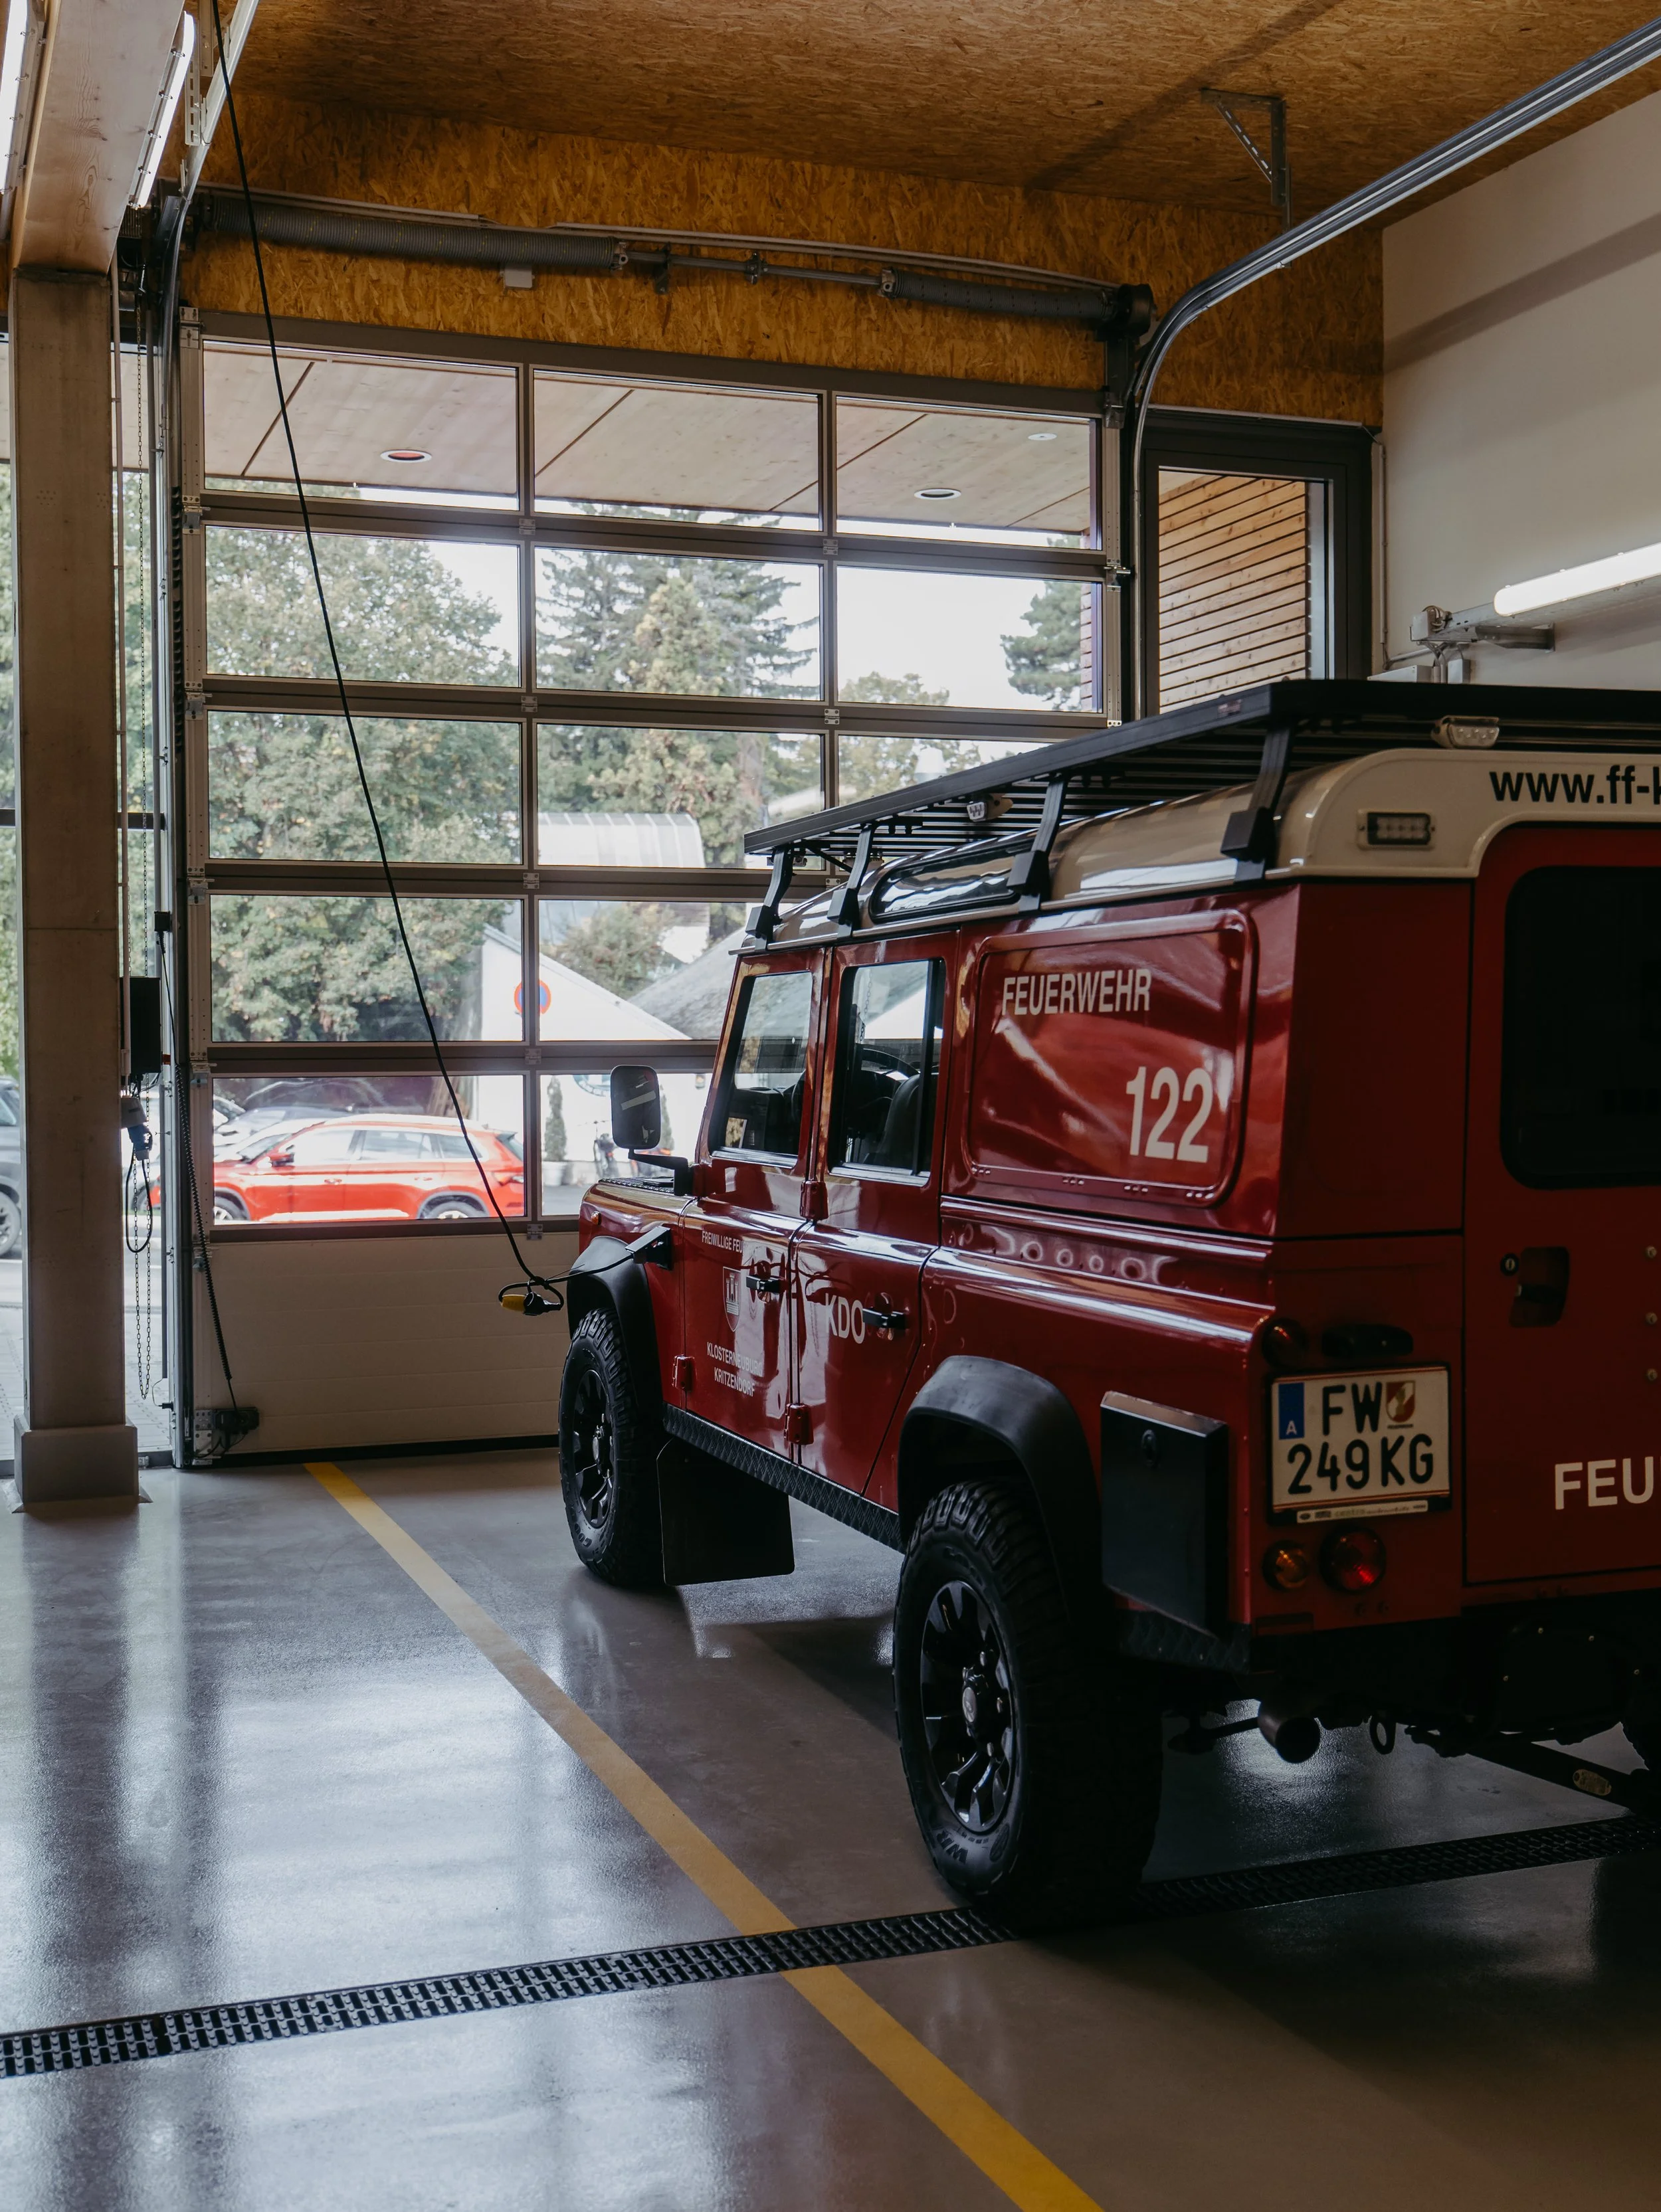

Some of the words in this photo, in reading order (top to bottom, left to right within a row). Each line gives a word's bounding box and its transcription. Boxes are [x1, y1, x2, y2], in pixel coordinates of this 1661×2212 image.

[1001, 968, 1151, 1016] FEUERWEHR
[1125, 1065, 1213, 1162] 122
[702, 1230, 732, 1250] FREIWILLIGE
[825, 1292, 866, 1344] KDO
[706, 1341, 763, 1377] KLOSTERNEUBURG
[714, 1366, 755, 1397] KRITZENDORF
[1286, 1420, 1297, 1435] A
[1322, 1381, 1383, 1436] FW
[1555, 1456, 1661, 1510] FEU
